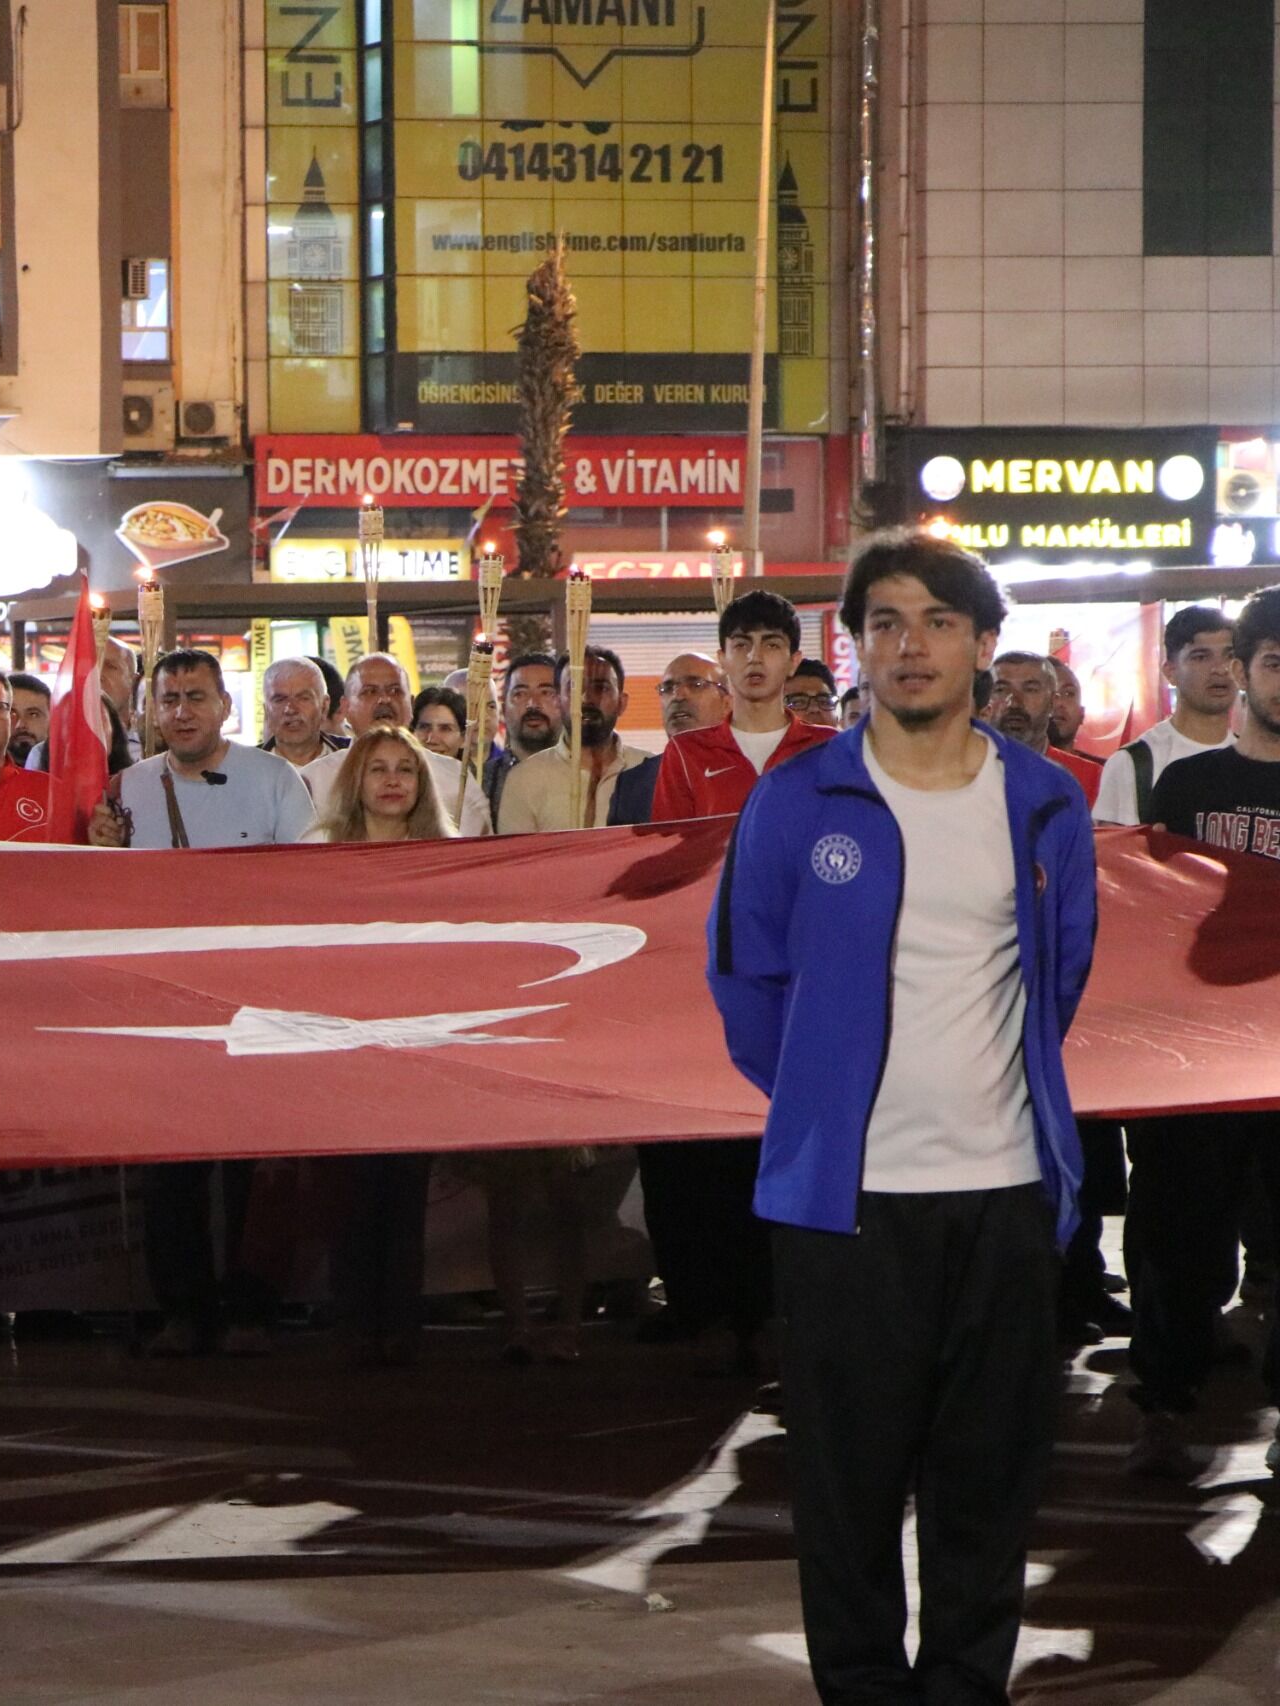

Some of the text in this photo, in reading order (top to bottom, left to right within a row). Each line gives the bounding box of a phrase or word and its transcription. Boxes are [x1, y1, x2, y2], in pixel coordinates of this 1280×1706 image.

[629, 143, 672, 183] 21
[681, 144, 724, 183] 21
[431, 231, 746, 254] www.englishime.com/sanliurfa
[594, 380, 644, 404] DEĞER
[653, 384, 705, 404] VEREN
[710, 384, 767, 404] KURU
[573, 458, 598, 495] &
[600, 449, 740, 495] VİTAMİN
[970, 459, 1155, 494] MERVAN
[942, 519, 1192, 548] NLU MAMÜLLERİ
[397, 550, 459, 577] TIME
[1236, 805, 1280, 817] CALIFORNI
